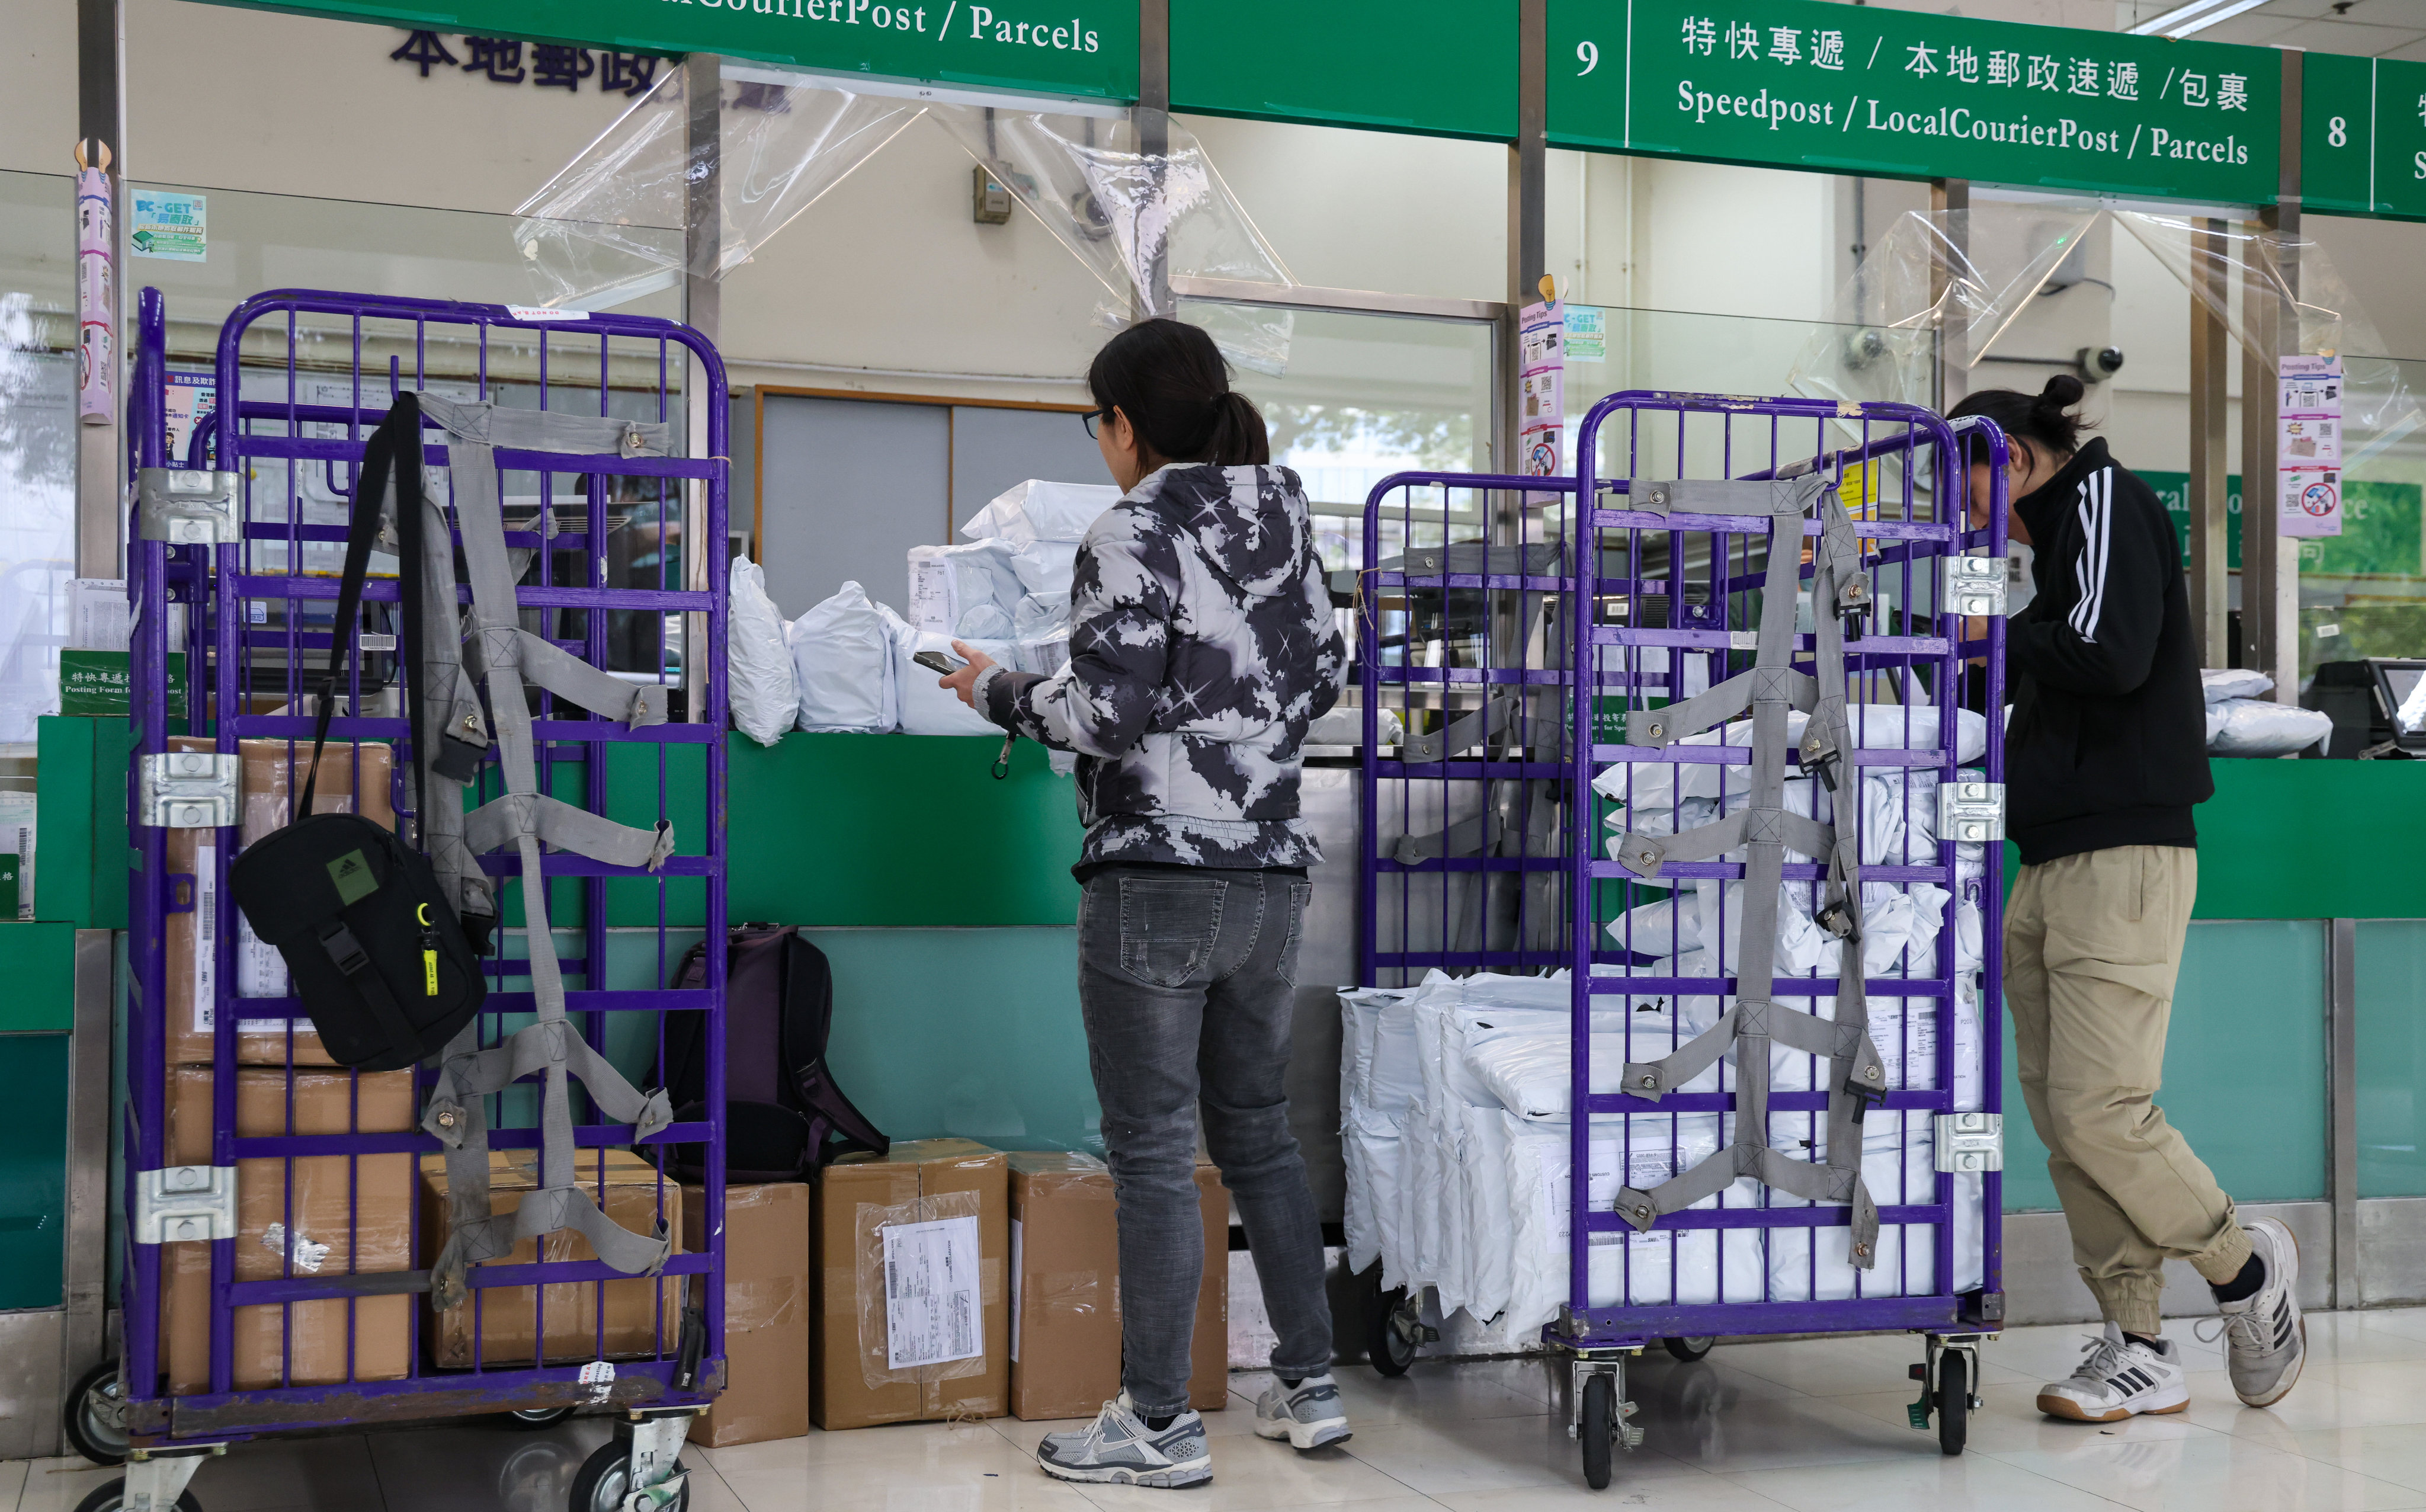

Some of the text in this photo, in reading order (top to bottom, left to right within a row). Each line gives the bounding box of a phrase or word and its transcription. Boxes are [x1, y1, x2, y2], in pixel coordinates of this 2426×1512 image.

[939, 1, 956, 41] /
[970, 6, 1098, 53] Parcels
[1576, 41, 1598, 76] 9
[1681, 16, 1844, 71] 特快專遞
[1867, 36, 1883, 69] /
[1905, 41, 2139, 101] 本地郵政速遞
[1678, 80, 2248, 165] Speedpost / LocalCourierPost / Parcels
[2328, 116, 2347, 147] 8
[165, 202, 191, 214] GET
[1537, 310, 1547, 320] Tips
[1577, 315, 1595, 323] GET
[66, 686, 97, 694] Posting
